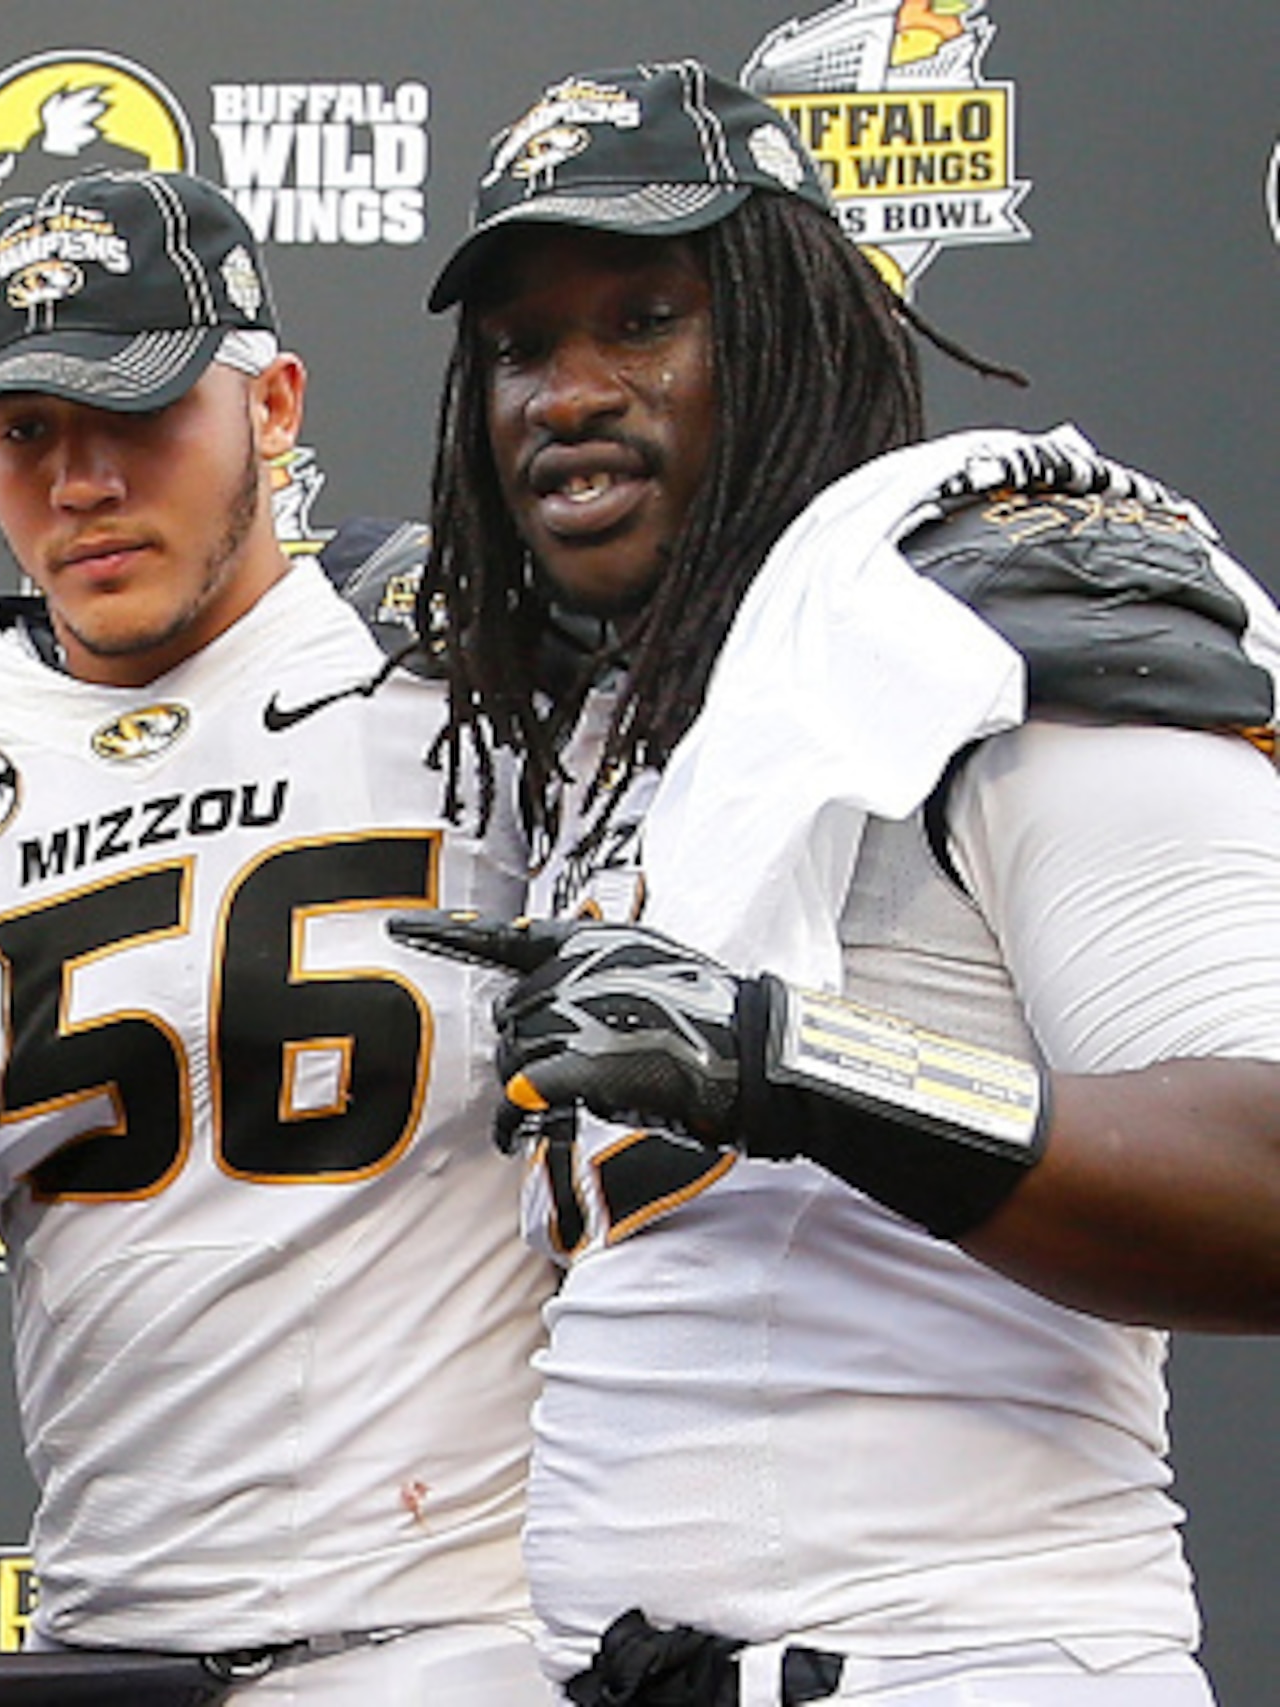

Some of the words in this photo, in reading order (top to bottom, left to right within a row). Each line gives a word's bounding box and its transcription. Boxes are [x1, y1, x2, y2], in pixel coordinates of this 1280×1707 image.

[210, 83, 429, 123] BUFFALO
[210, 123, 428, 189] WILD
[854, 150, 992, 189] WINGS
[882, 201, 992, 233] BOWL
[20, 781, 290, 887] MIZZOU
